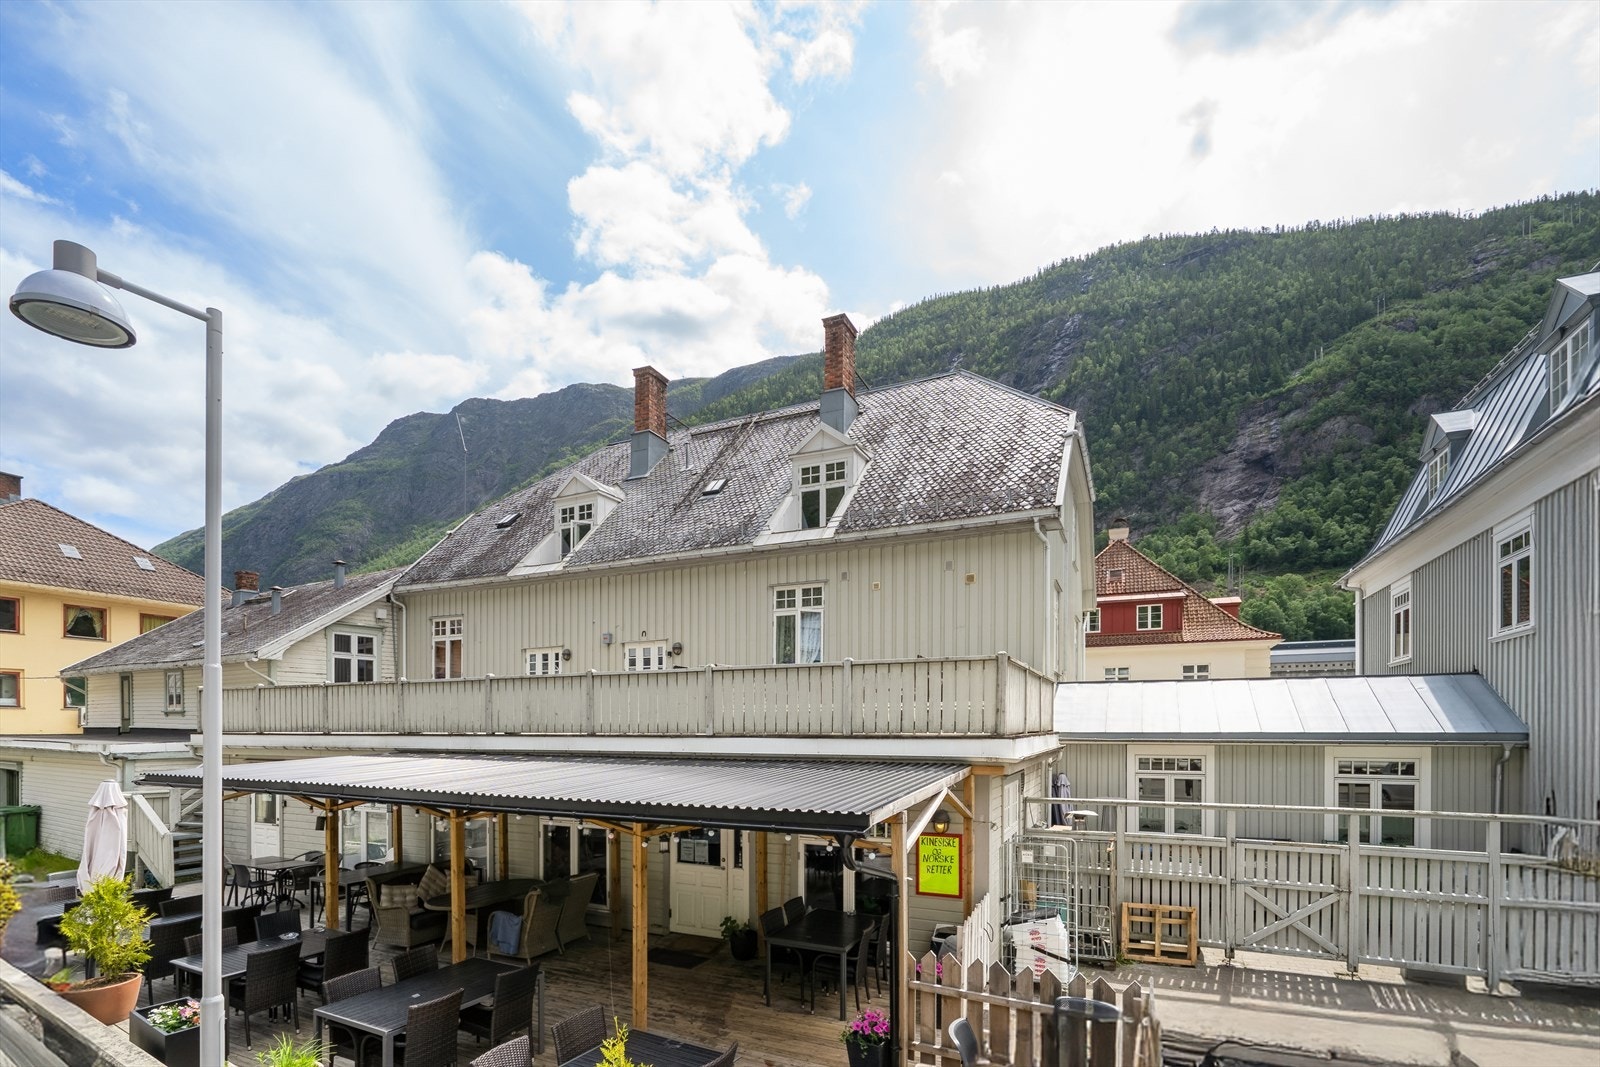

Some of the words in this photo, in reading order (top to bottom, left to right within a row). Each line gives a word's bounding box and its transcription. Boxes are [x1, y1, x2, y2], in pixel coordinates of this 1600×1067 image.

[921, 837, 956, 847] KINESISKE
[923, 854, 954, 863] NORSKE
[926, 865, 952, 874] RETTER
